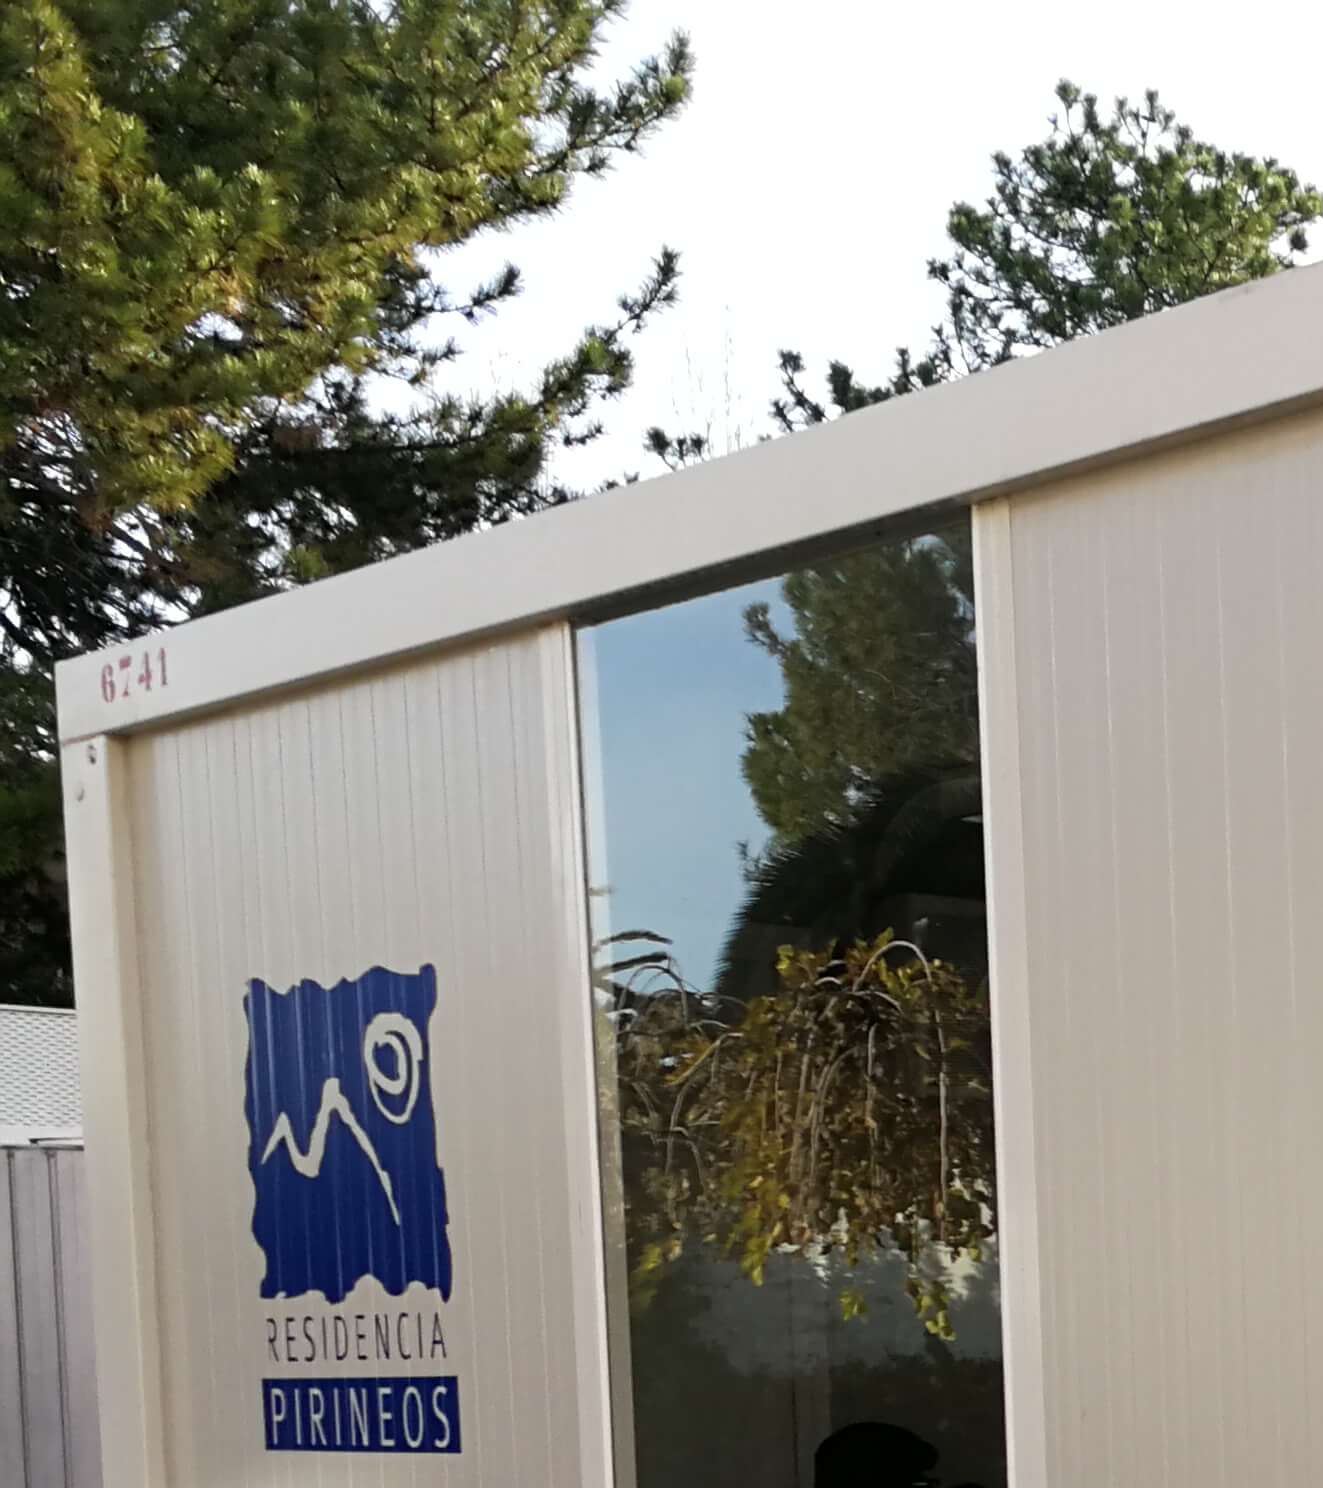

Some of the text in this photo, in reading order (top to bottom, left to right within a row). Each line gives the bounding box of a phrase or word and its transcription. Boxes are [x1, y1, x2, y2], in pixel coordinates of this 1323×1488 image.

[101, 648, 168, 703] 6741
[266, 1312, 447, 1362] RESIDENCIA
[271, 1386, 452, 1447] PIRINEOS
